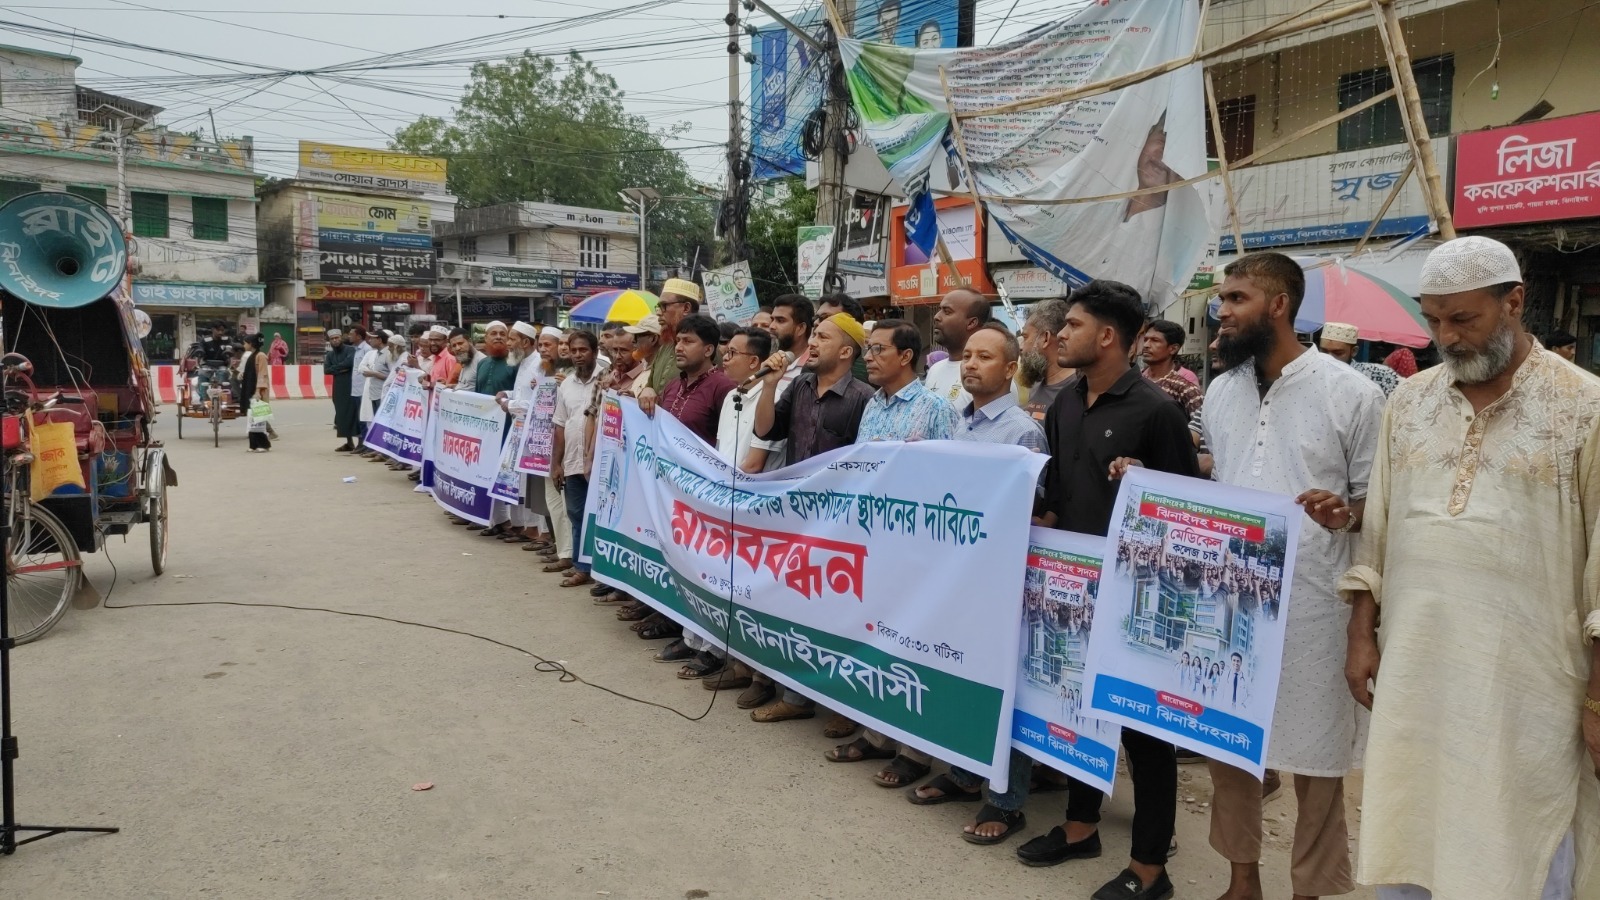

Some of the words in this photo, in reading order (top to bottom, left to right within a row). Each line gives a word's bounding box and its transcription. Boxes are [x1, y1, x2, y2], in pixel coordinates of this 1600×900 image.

[1497, 135, 1577, 176] লিজা
[368, 206, 397, 221] ফোম
[898, 275, 919, 290] শাওমি
[943, 273, 972, 288] Xiami
[169, 286, 196, 301] ভাই
[198, 286, 224, 303] কৃষি
[786, 488, 857, 525] হাসপাতাল
[857, 492, 919, 538] স্থাপনের
[1144, 492, 1185, 509] ঝিনাইদহের
[1187, 502, 1213, 514] উন্নয়নে
[1156, 506, 1210, 527] ঝিনাইদহ
[1212, 519, 1249, 537] সদরে
[1170, 527, 1223, 551] মেডিকেল
[671, 499, 869, 604] মানববন্ধন
[1171, 542, 1201, 559] কলেজ
[1202, 546, 1220, 563] চাই
[1038, 557, 1075, 574] ঝিনাইদহ
[1077, 566, 1099, 579] সদরে
[1048, 574, 1084, 592] মেডিকেল
[1069, 593, 1081, 604] চাই
[899, 635, 930, 653] ০৫:৩০
[933, 642, 964, 665] ঘটিকা
[733, 609, 931, 717] ঝিনাইদহবাসী
[1107, 692, 1151, 716] আমরা
[1156, 706, 1252, 751] ঝিনাইদহবাসী
[1019, 725, 1045, 745] আমরা
[1047, 735, 1110, 774] ঝিনাইদহবাসী
